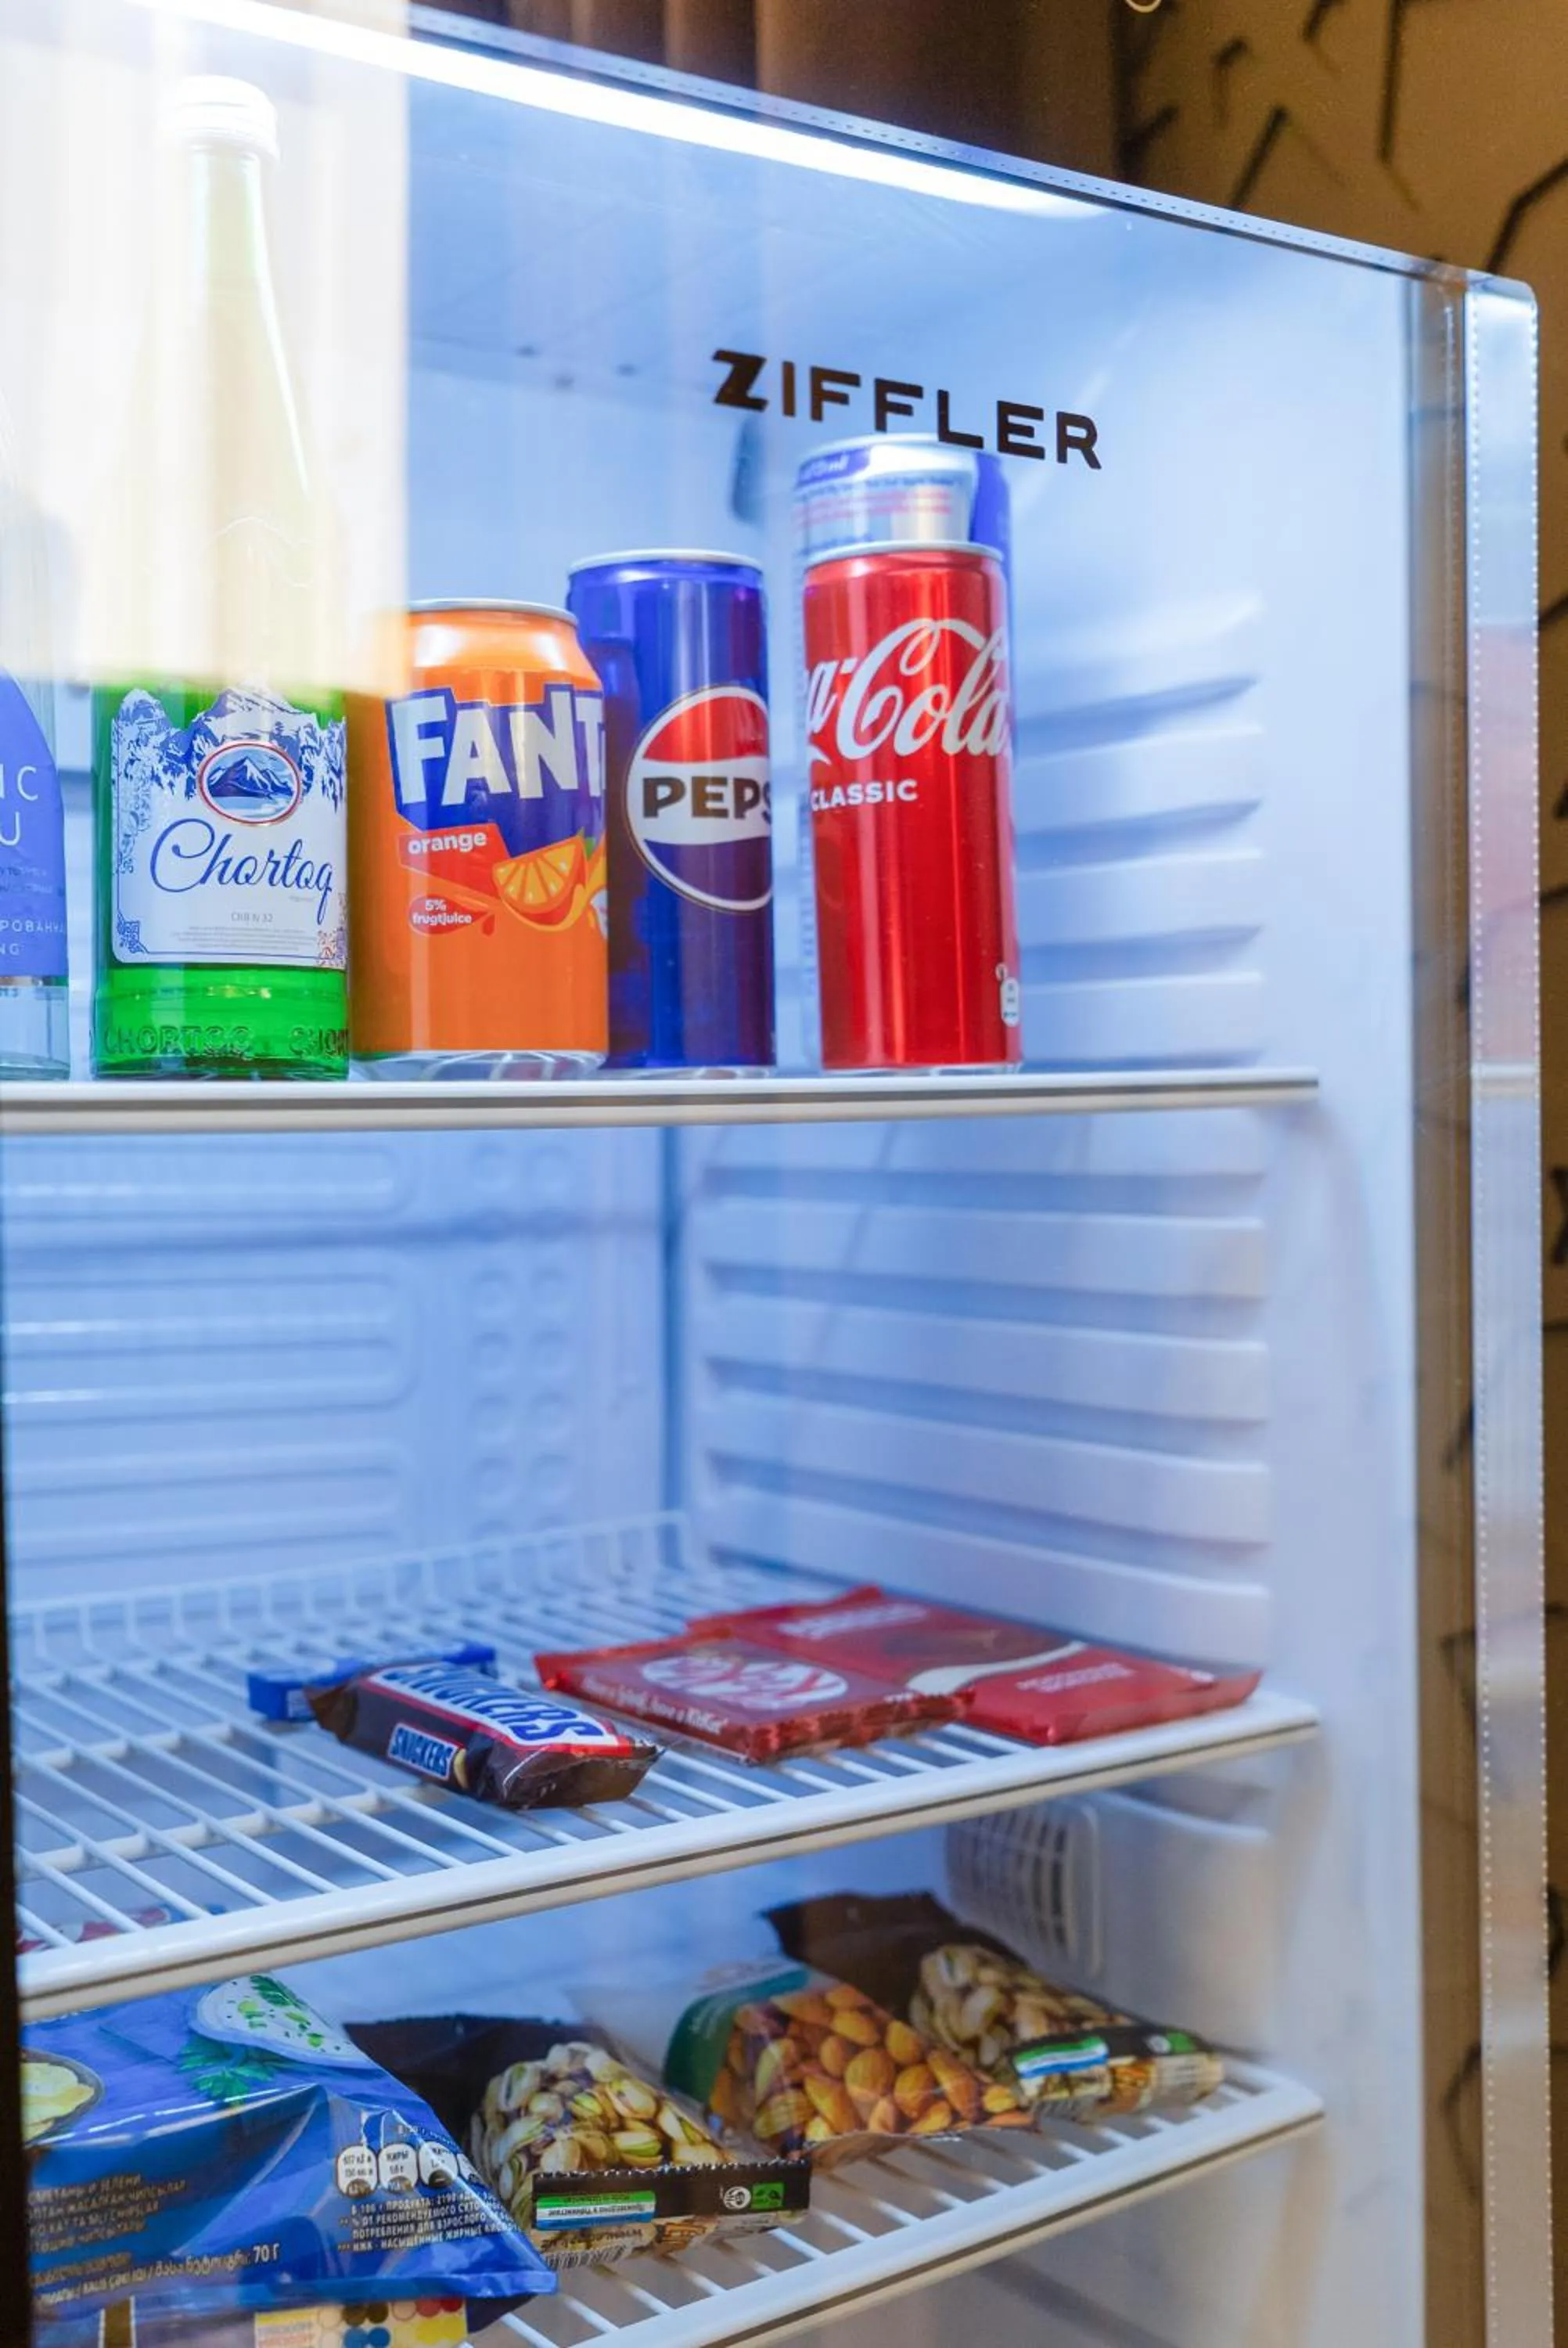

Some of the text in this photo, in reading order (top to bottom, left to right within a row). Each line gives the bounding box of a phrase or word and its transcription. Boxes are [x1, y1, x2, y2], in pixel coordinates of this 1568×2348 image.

[711, 349, 1102, 470] ZIFFLER
[391, 690, 606, 806] FANT
[811, 780, 918, 811] CLASSIC
[408, 831, 487, 854] orange
[150, 818, 333, 924] Chortoq
[412, 912, 473, 925] frugtjuice
[425, 899, 447, 912] 5%
[379, 1666, 606, 1742] SNICKERS
[390, 1727, 455, 1777] SNICKERS
[252, 2244, 270, 2264] 70
